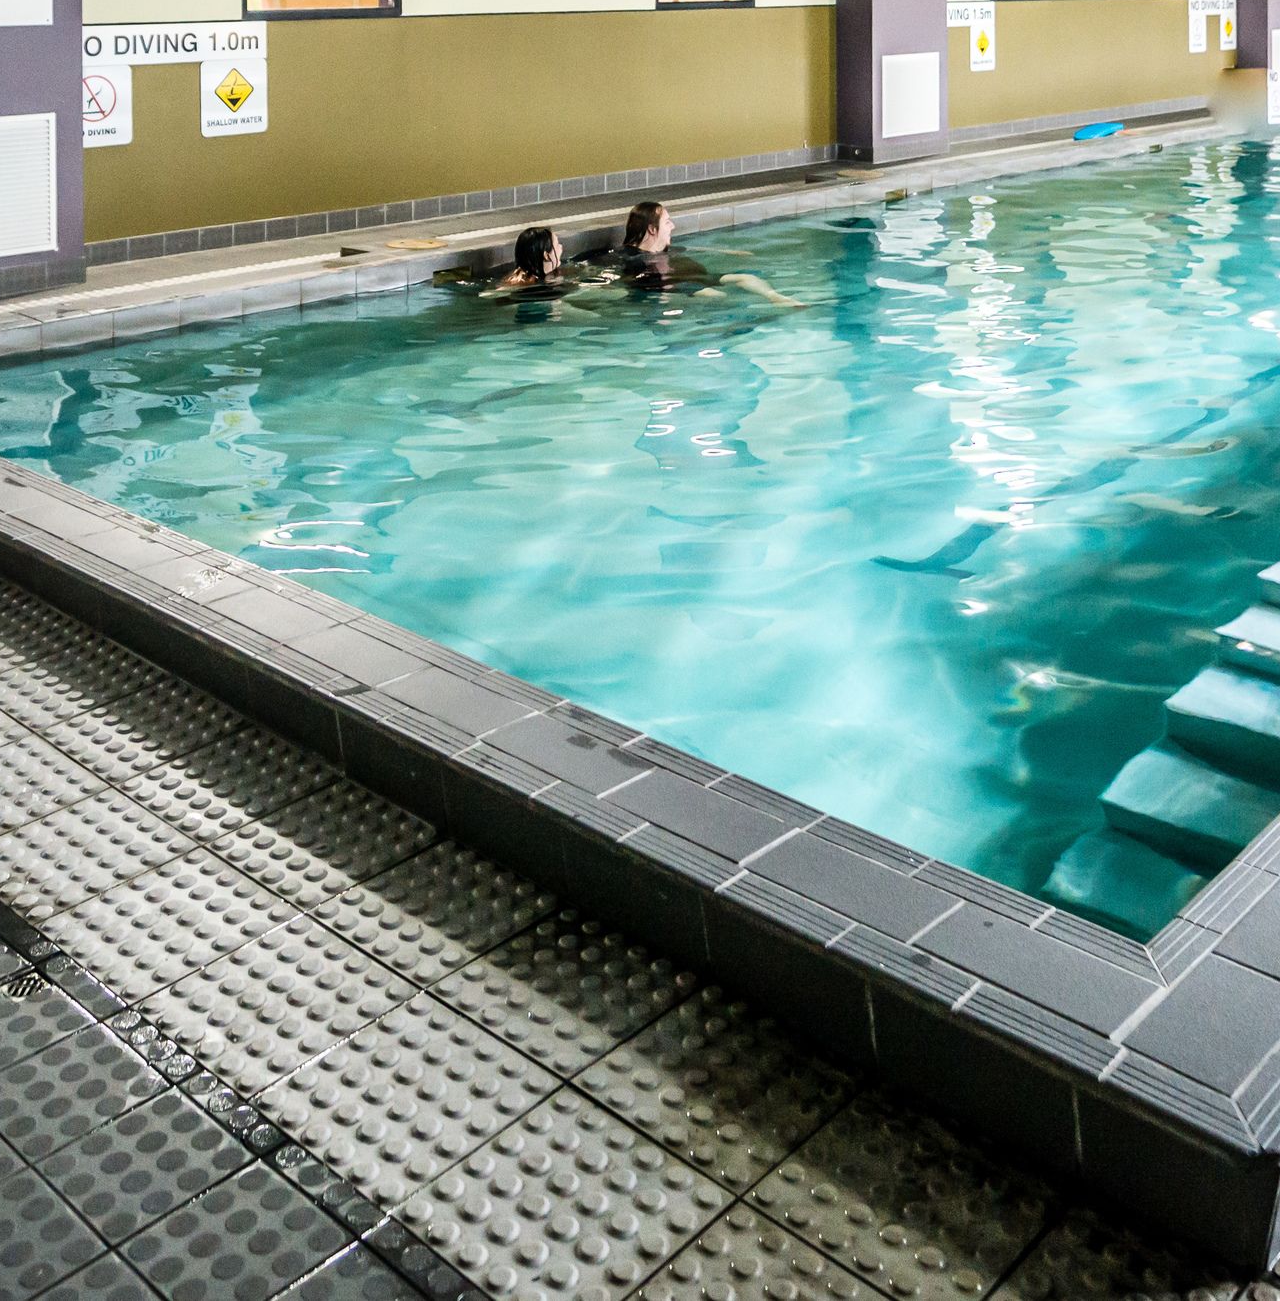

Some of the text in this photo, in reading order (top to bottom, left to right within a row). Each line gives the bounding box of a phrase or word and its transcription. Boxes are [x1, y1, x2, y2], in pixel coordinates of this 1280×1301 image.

[1191, 0, 1200, 11] NO
[1201, 0, 1220, 11] DIVING
[84, 32, 259, 56] O DIVING 1.0m
[206, 116, 263, 128] SHALLOW WATER
[87, 127, 117, 137] DIVING
